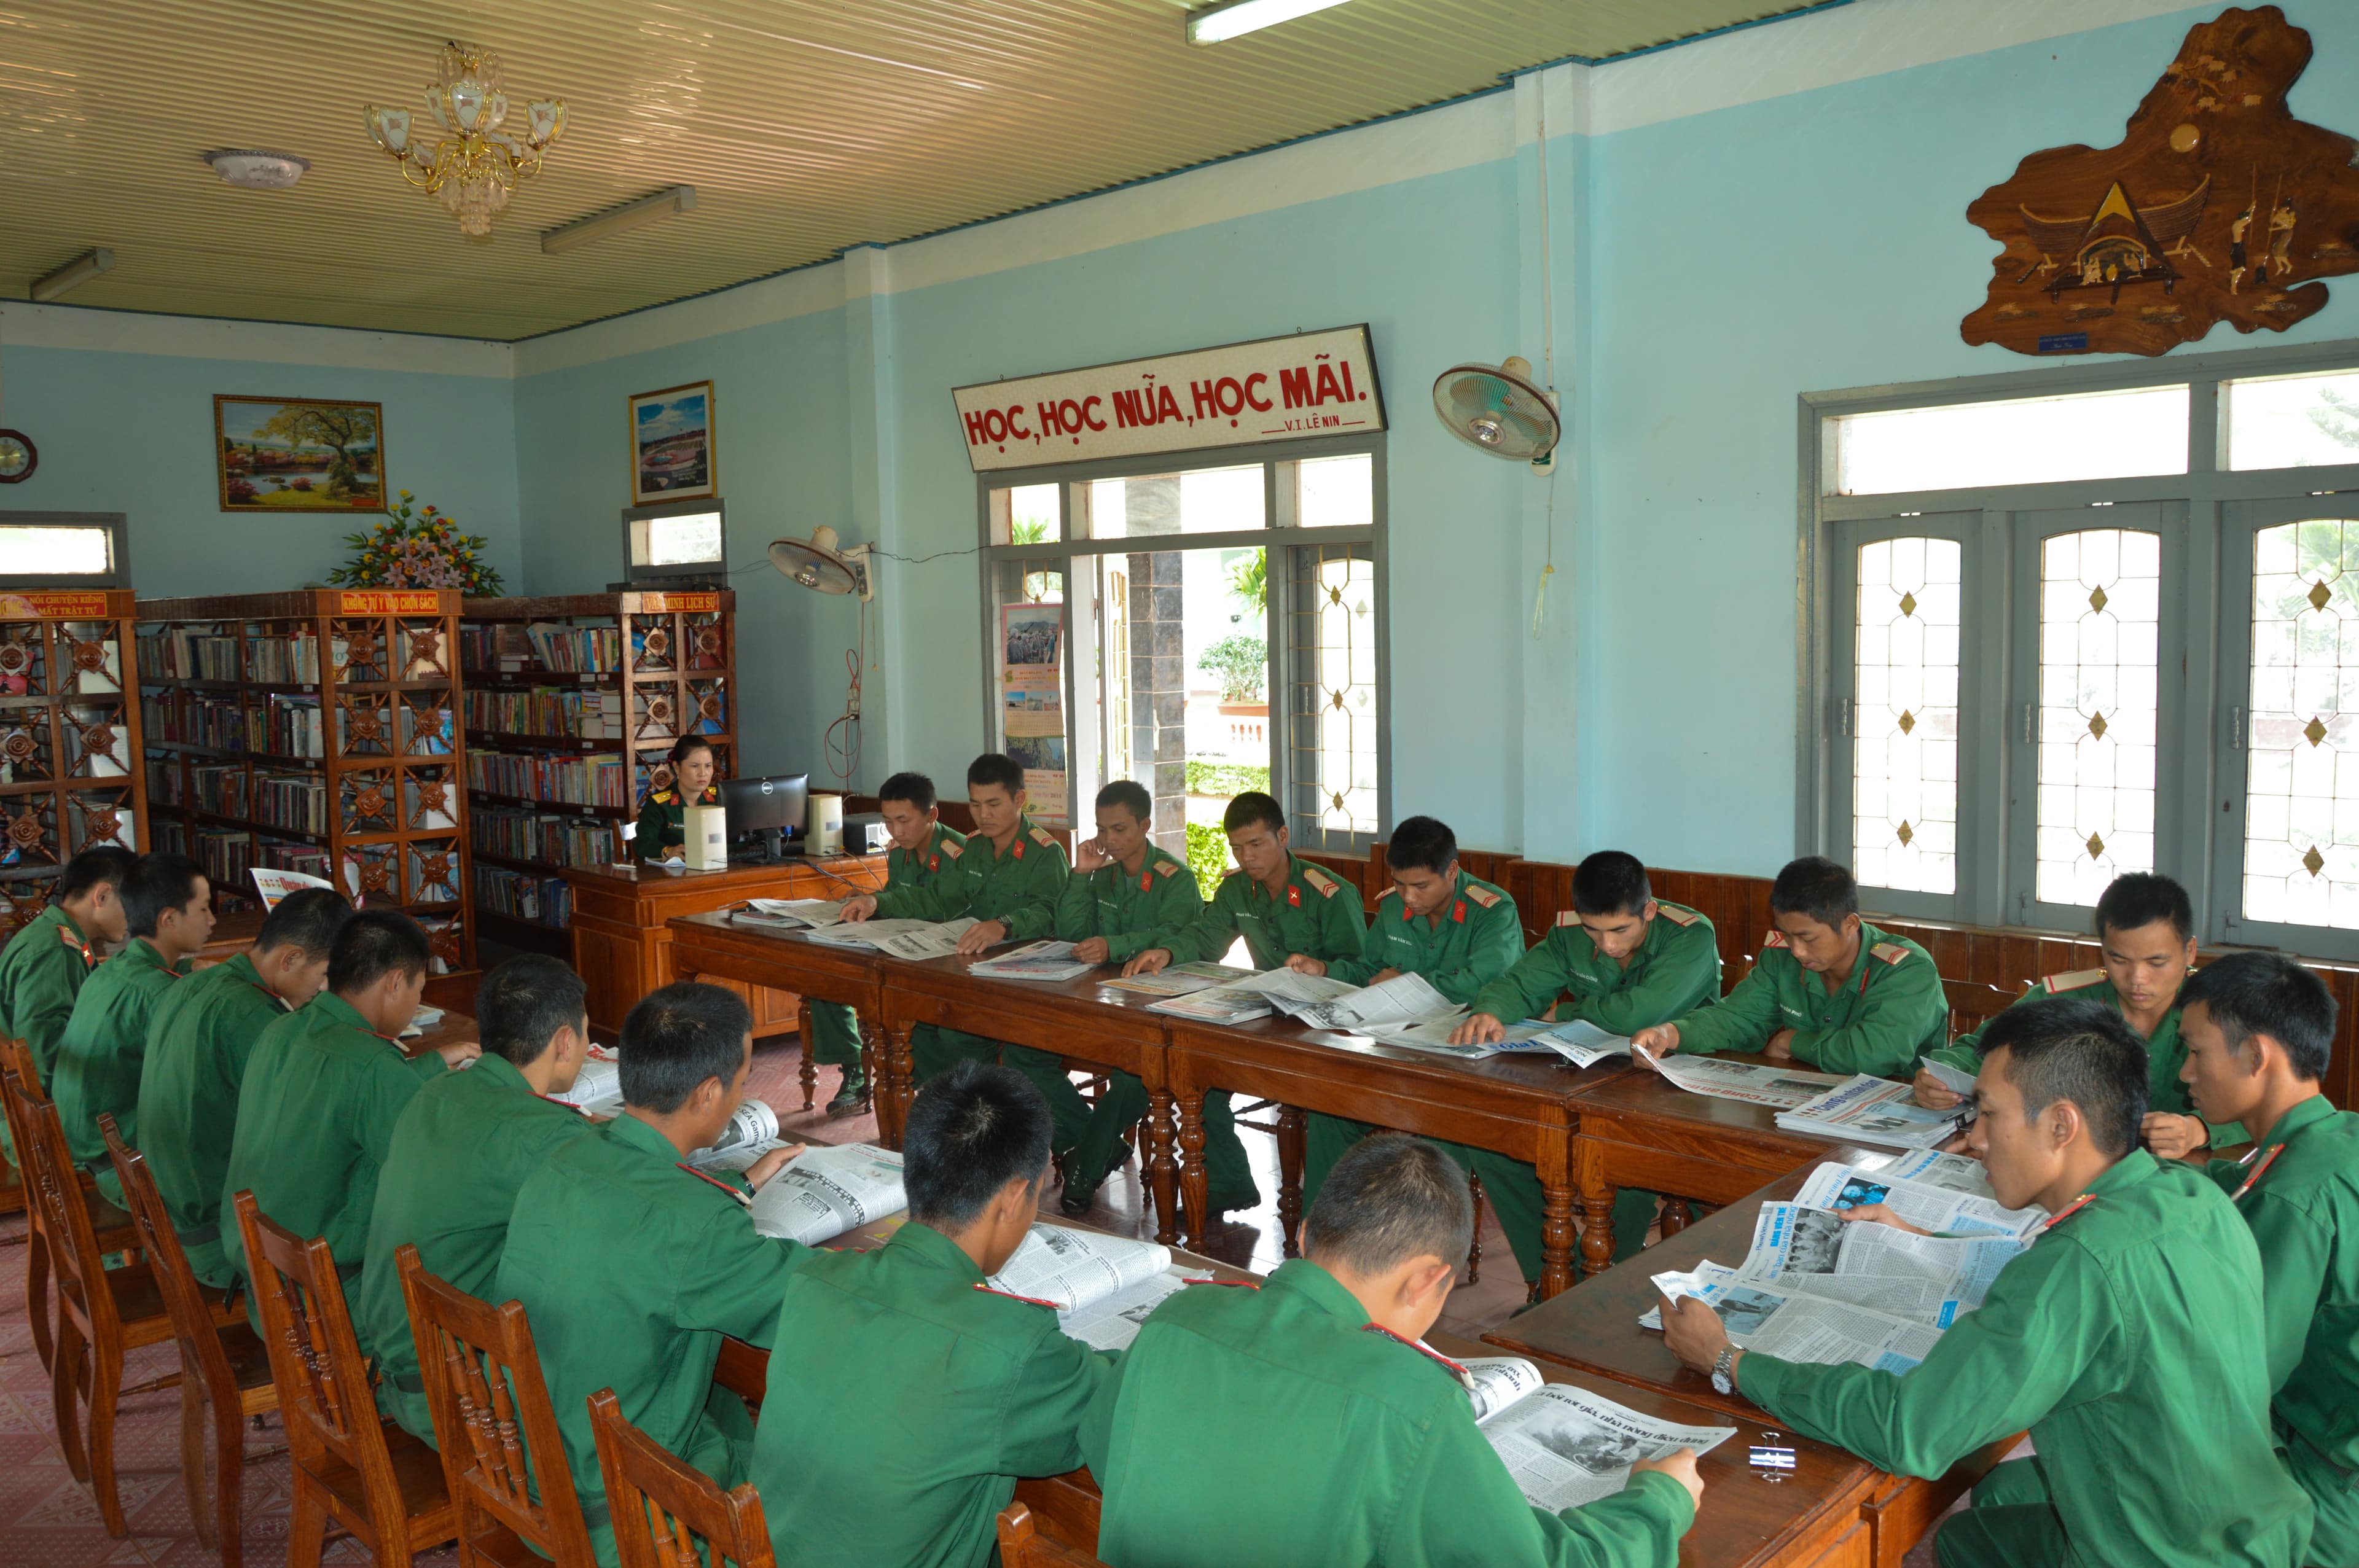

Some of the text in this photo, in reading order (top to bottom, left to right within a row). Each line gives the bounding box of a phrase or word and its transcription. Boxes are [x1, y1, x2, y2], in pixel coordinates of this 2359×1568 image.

[964, 354, 1367, 453] HỌC, HỌC NỮA, HỌC MÃI.
[1322, 415, 1340, 428] NIN
[46, 595, 78, 605] CHUYỆN
[420, 595, 436, 609] SÁCH
[665, 598, 684, 609] MINH
